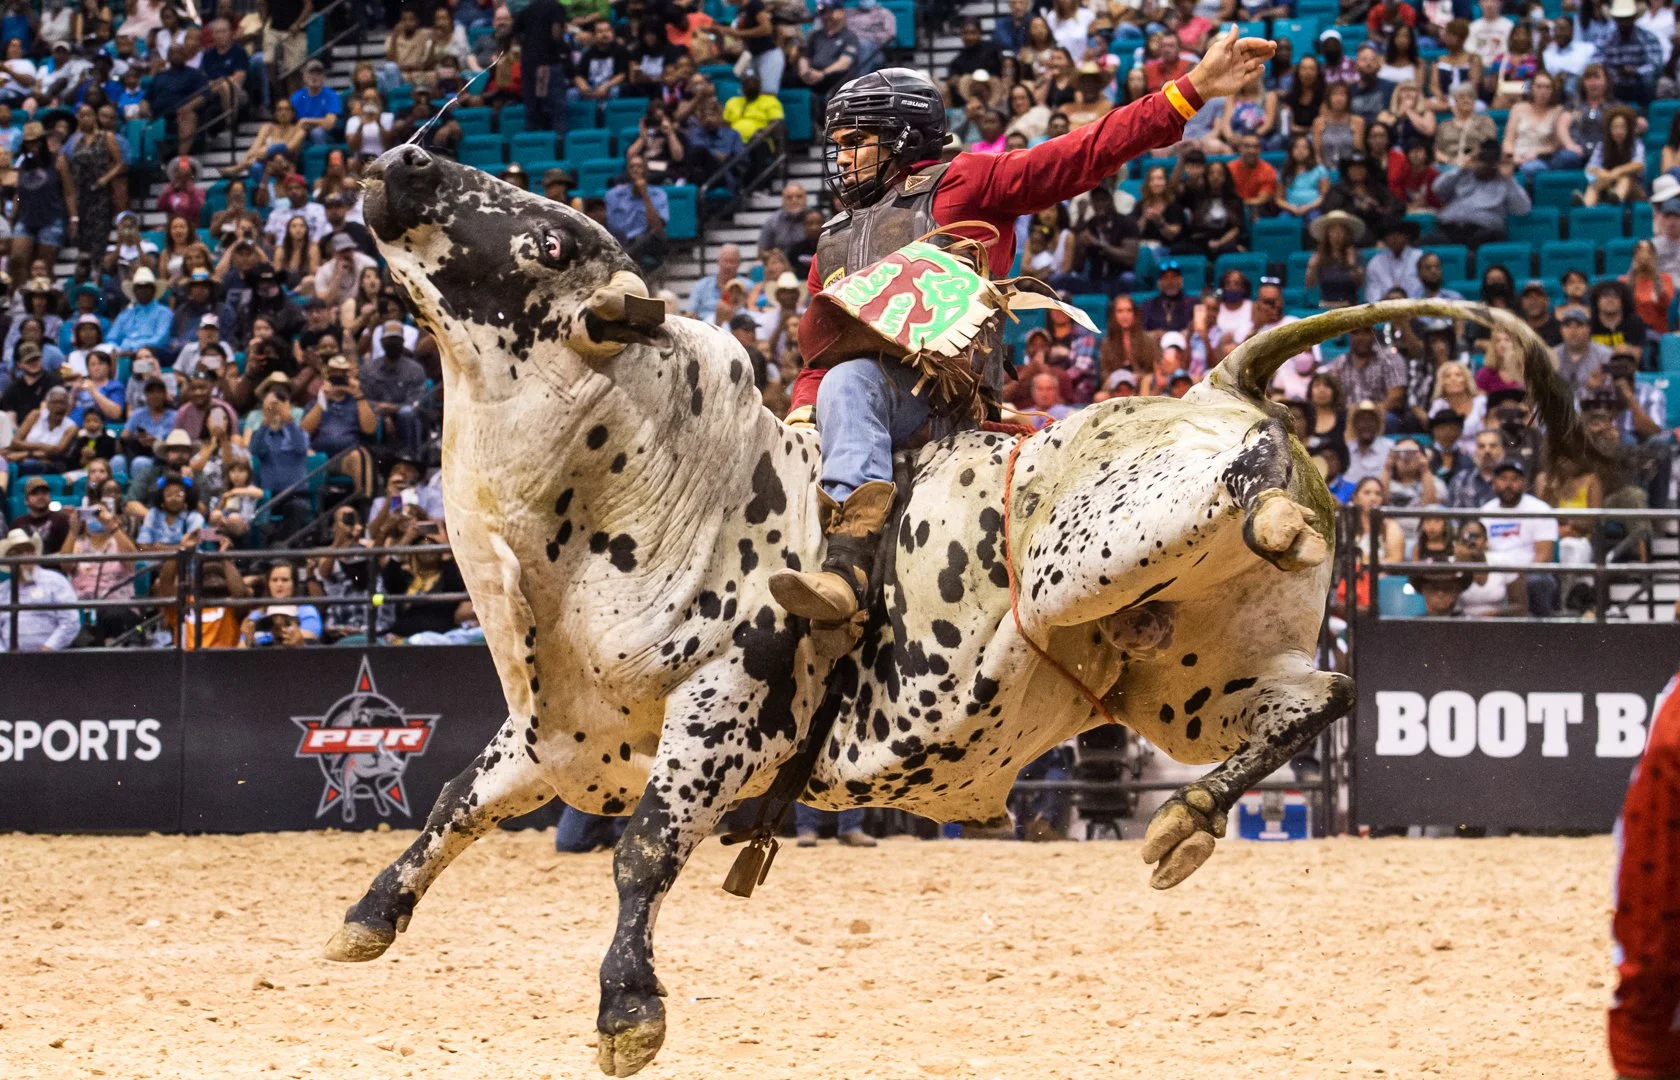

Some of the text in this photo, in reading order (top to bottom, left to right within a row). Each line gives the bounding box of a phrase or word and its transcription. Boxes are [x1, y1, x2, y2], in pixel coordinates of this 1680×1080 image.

[0, 718, 162, 762] SPORTS
[308, 729, 424, 748] PBR
[1375, 690, 1663, 758] BOOT B
